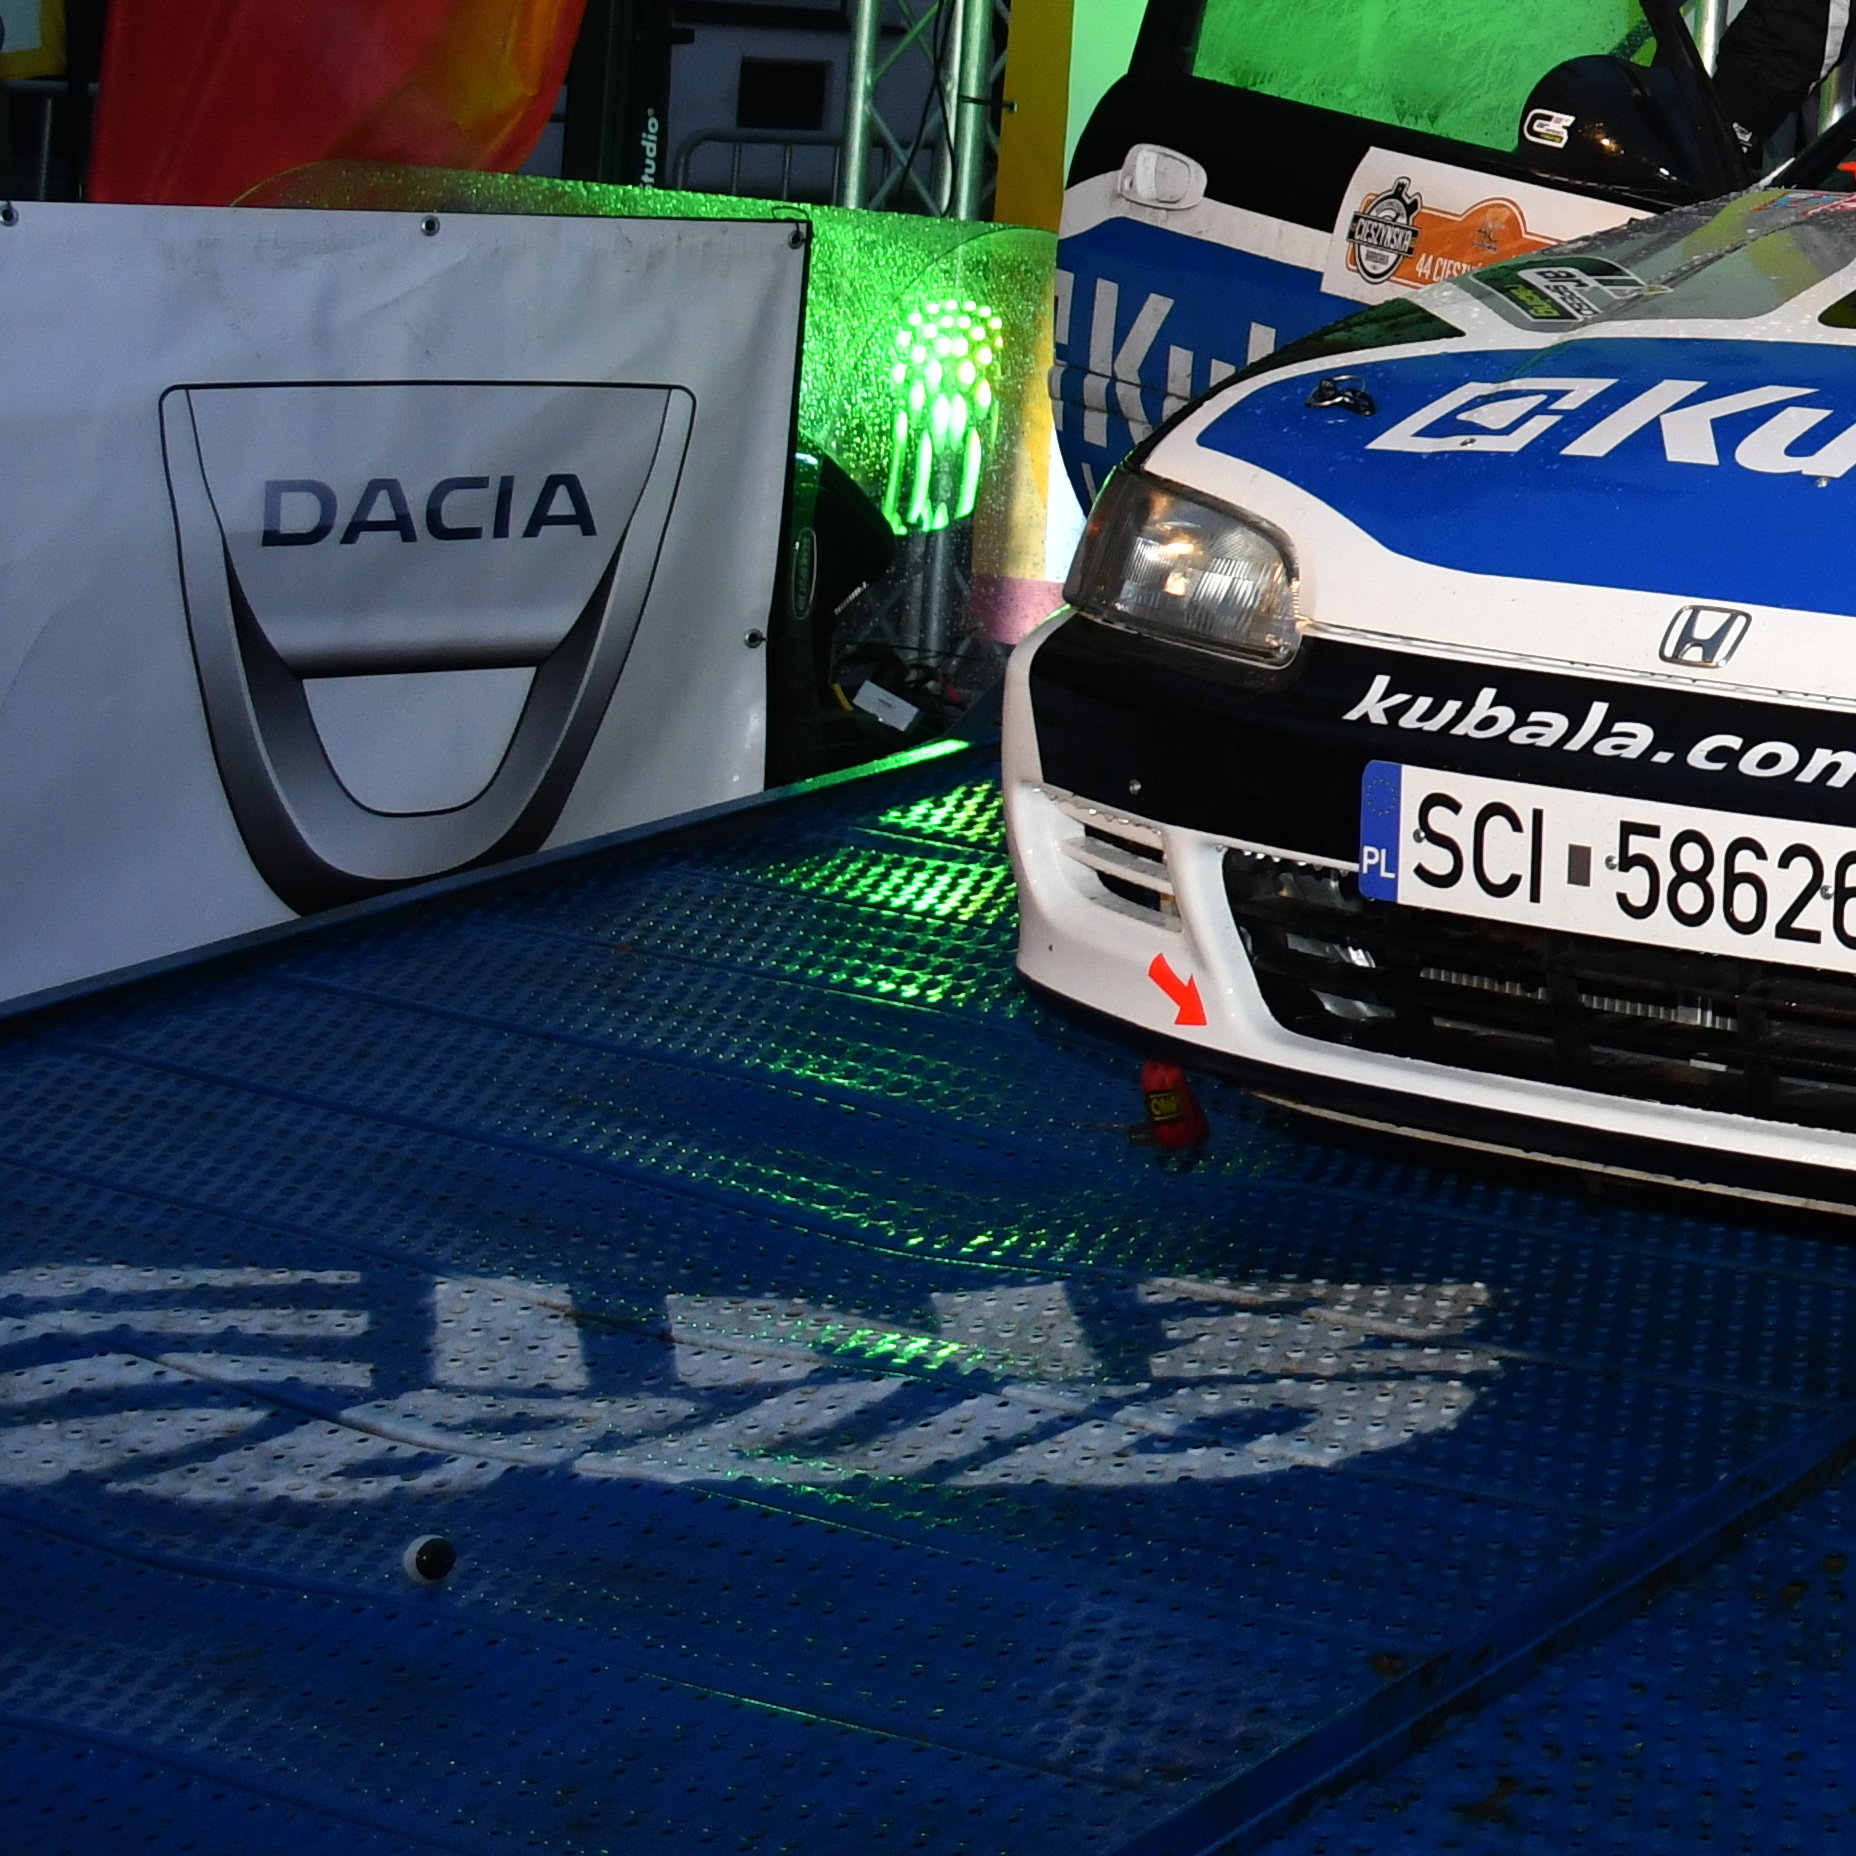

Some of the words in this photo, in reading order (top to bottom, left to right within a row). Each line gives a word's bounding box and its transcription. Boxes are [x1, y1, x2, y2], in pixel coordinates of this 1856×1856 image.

[1415, 253, 1433, 279] 44
[260, 473, 598, 548] DACIA
[1361, 845, 1396, 881] PL
[1412, 791, 1545, 905] SCI
